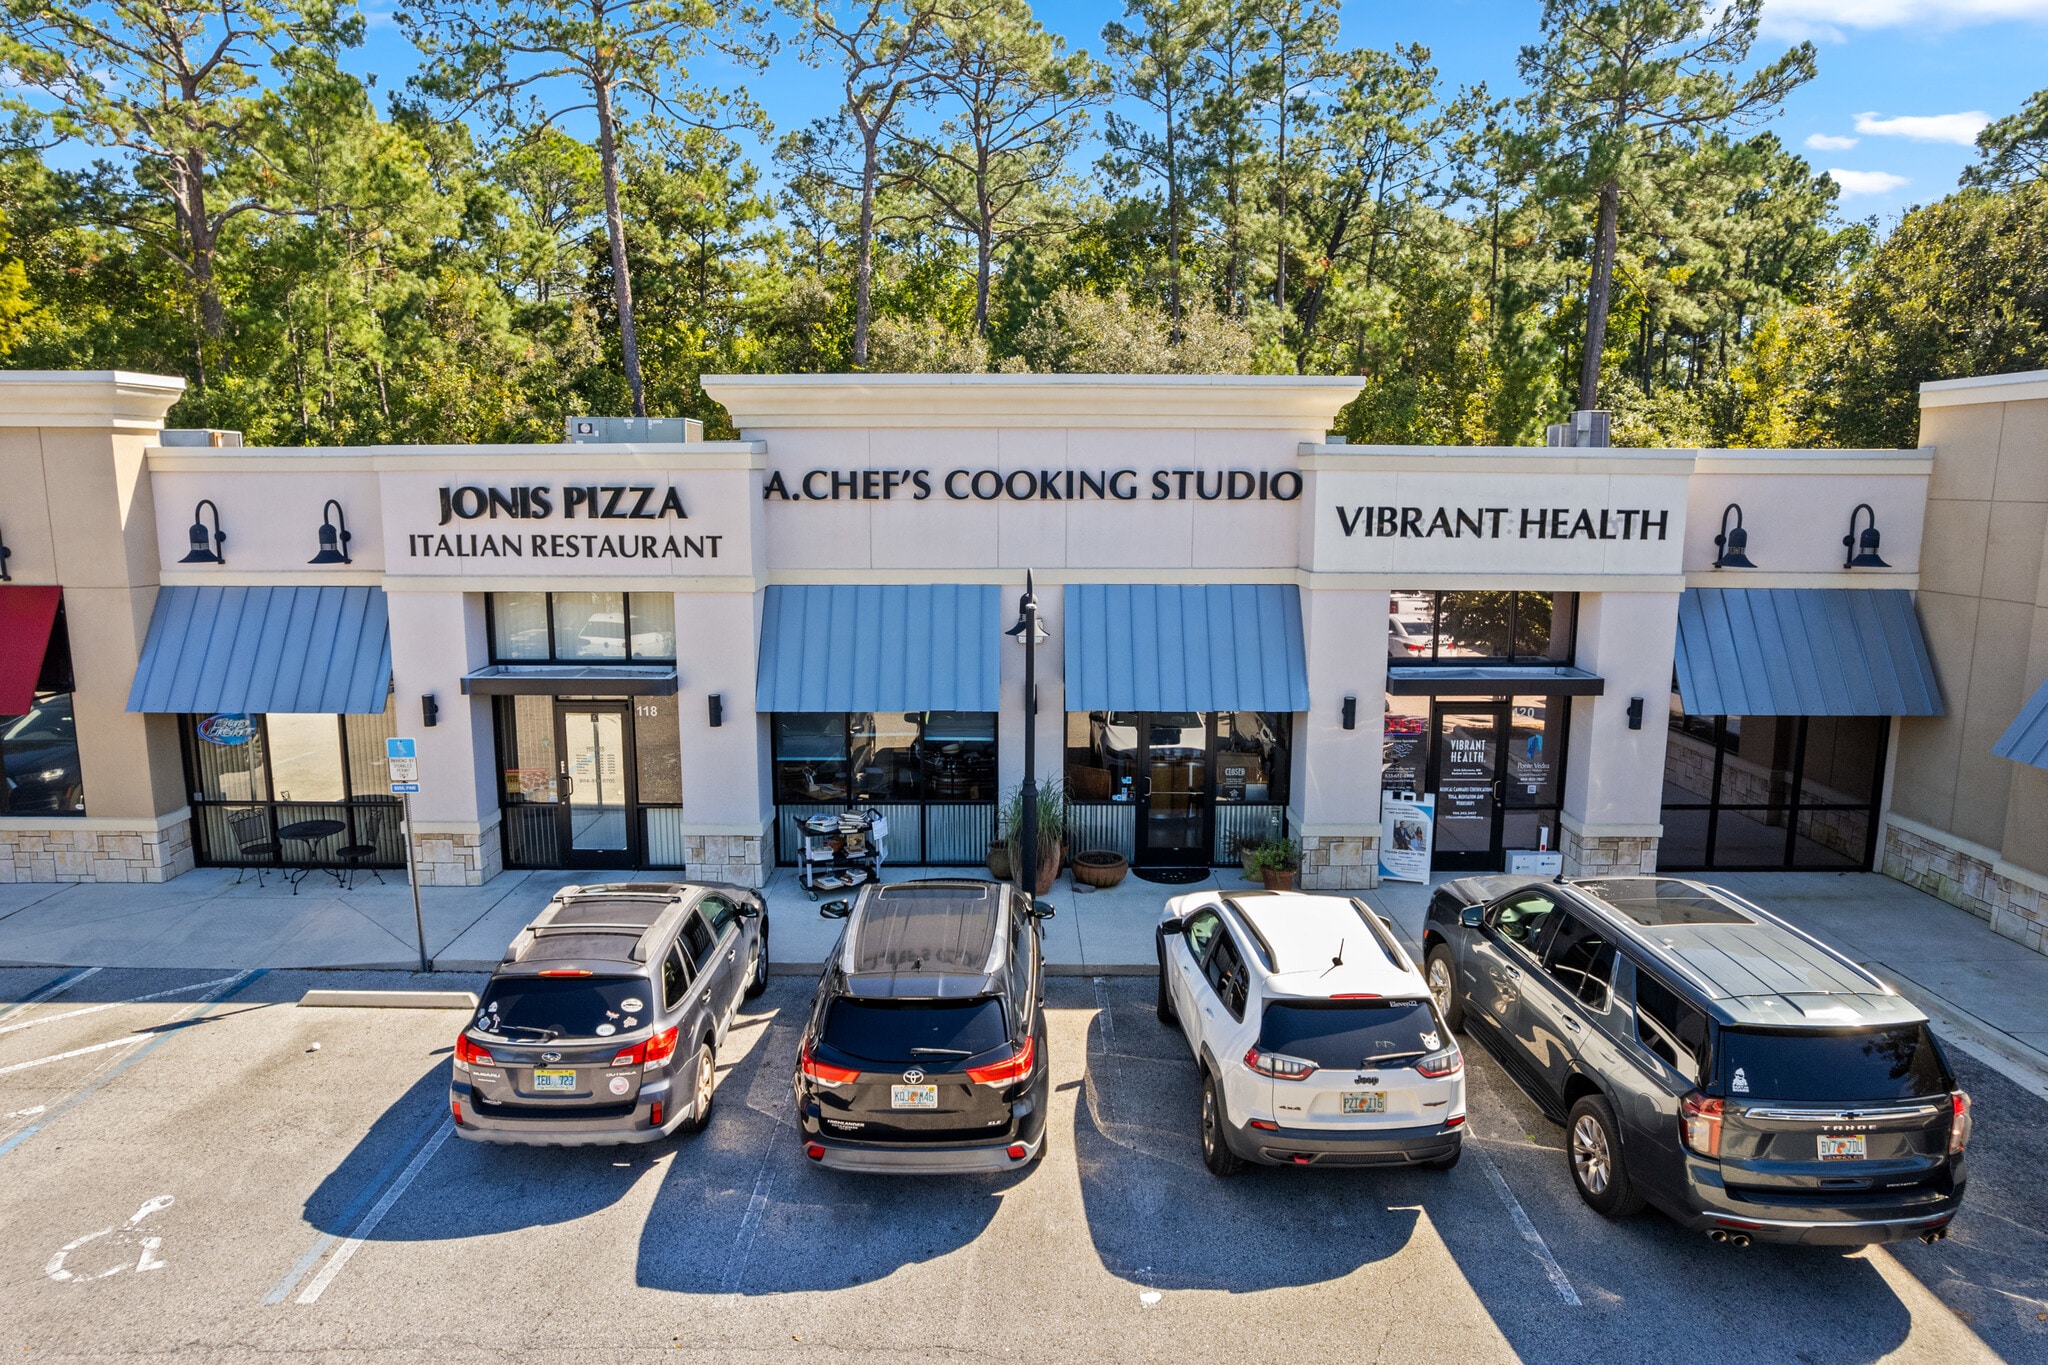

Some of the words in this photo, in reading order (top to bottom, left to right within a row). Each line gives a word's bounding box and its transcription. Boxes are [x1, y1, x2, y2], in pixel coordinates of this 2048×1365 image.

[763, 468, 931, 501] A.CHEF'S
[944, 469, 1138, 501] COOKING
[1151, 470, 1303, 501] STUDIO
[438, 486, 553, 527] JONIS
[562, 486, 689, 520] PIZZA
[1335, 506, 1509, 539] VIBRANT
[1519, 508, 1669, 541] HEALTH
[409, 534, 522, 557] ITALIAN
[531, 534, 723, 559] RESTAURANT
[636, 705, 658, 717] 118
[1512, 707, 1535, 718] 120
[1384, 718, 1421, 733] OPEN
[1451, 739, 1486, 751] VIBRANT
[1225, 768, 1245, 776] CLOSED
[472, 1071, 501, 1079] SUBARU
[536, 1075, 551, 1086] IEU
[559, 1075, 574, 1086] 723
[1354, 1074, 1380, 1086] Jeep
[827, 1118, 865, 1128] HIGHLANDER
